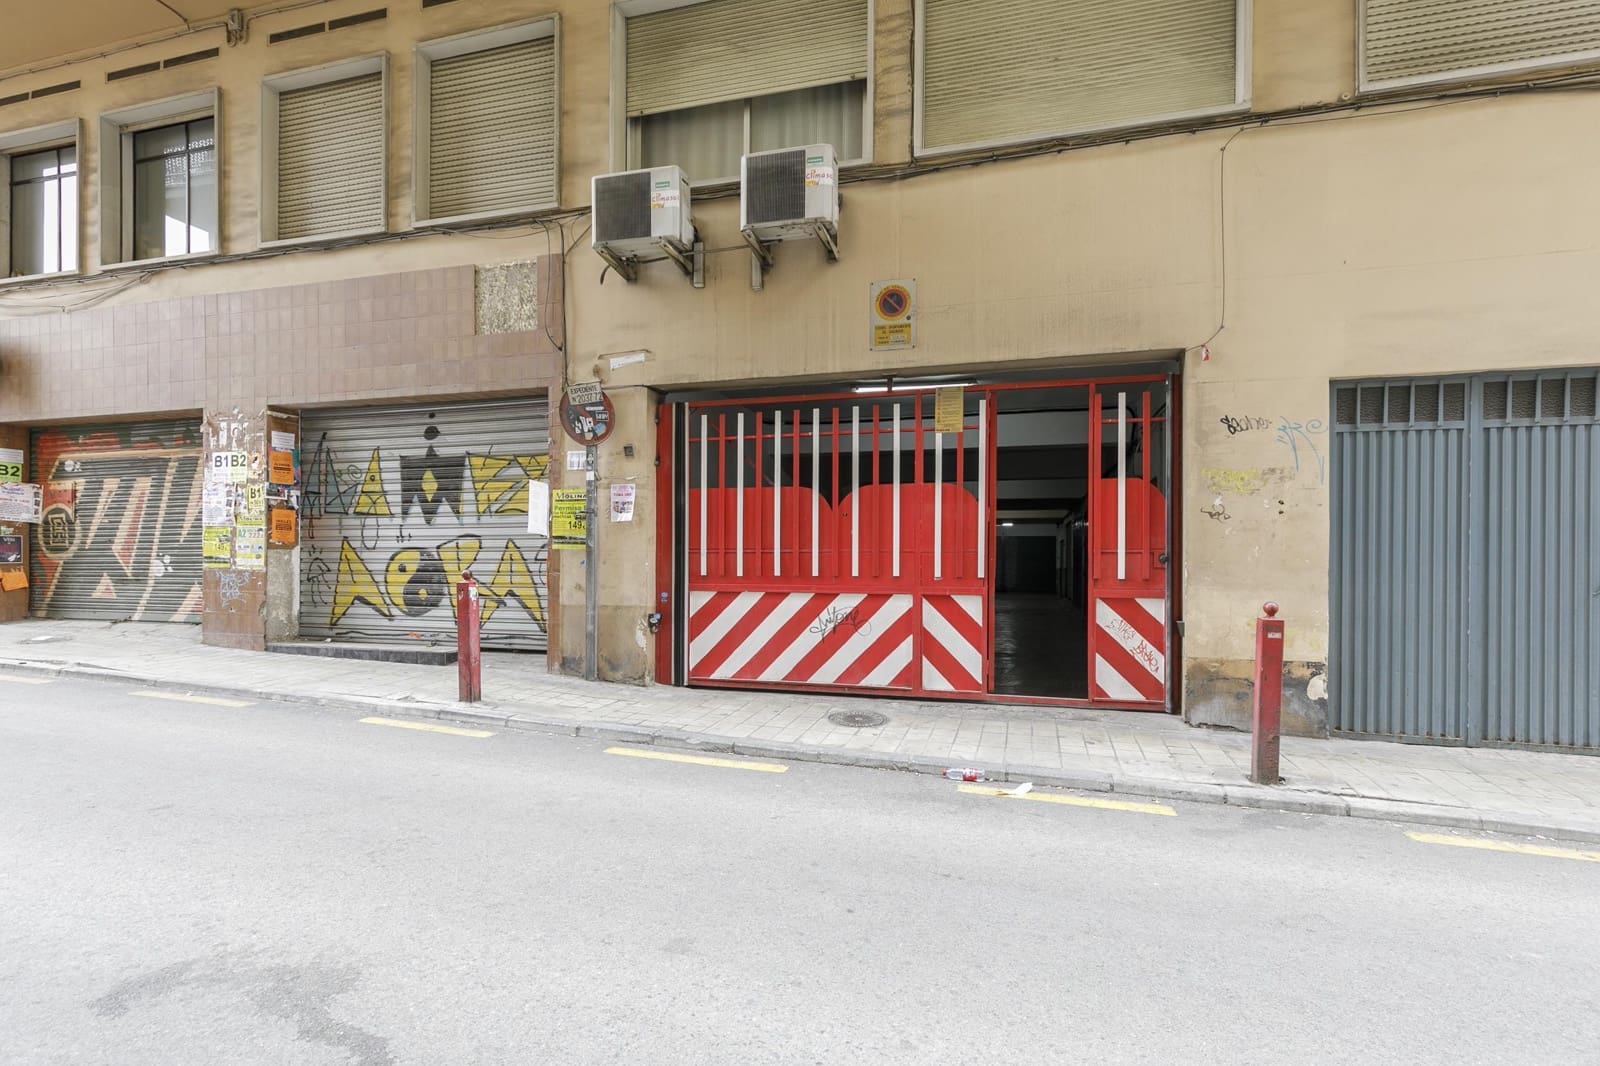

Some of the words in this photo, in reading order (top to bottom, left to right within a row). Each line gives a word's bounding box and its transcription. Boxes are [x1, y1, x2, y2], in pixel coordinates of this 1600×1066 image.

[570, 385, 600, 395] EXPEDIENTE
[214, 455, 229, 468] B1
[231, 454, 247, 467] B2
[250, 487, 261, 499] B1
